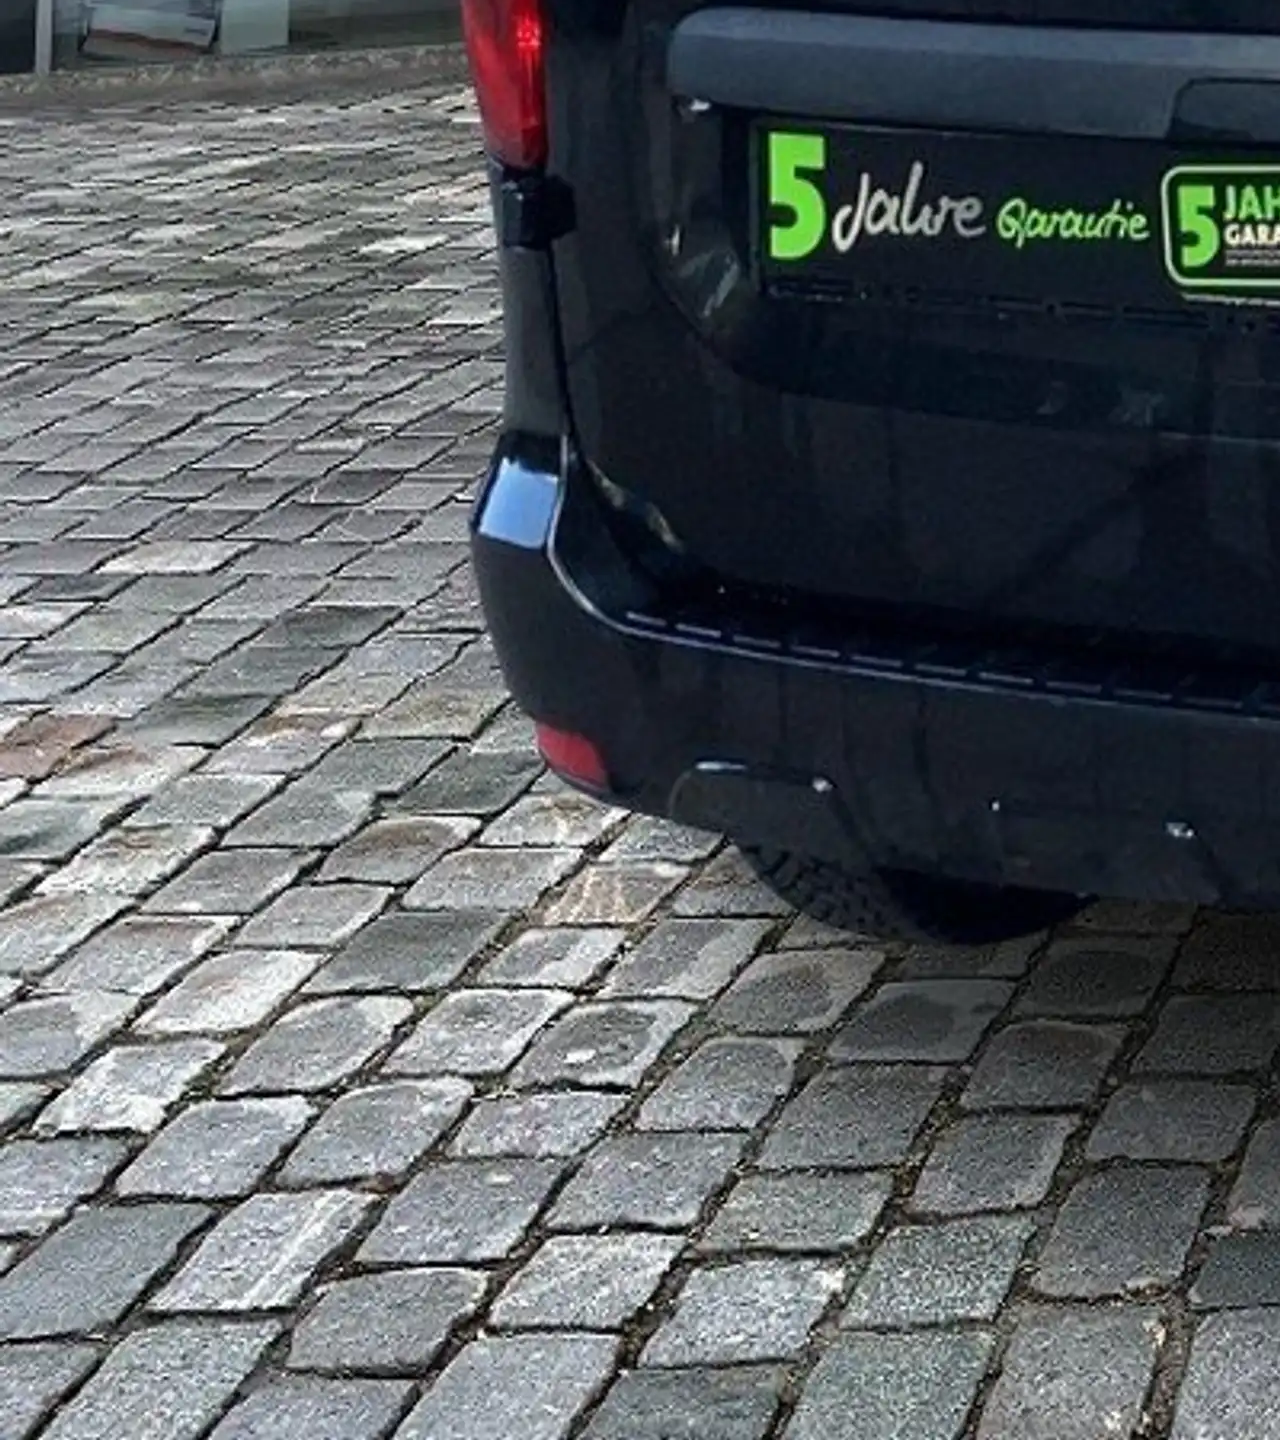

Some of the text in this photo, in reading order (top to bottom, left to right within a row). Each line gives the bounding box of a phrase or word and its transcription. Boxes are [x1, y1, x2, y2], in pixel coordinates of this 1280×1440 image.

[768, 131, 1151, 259] 5 Jahre Garantie
[1177, 184, 1220, 268] 5
